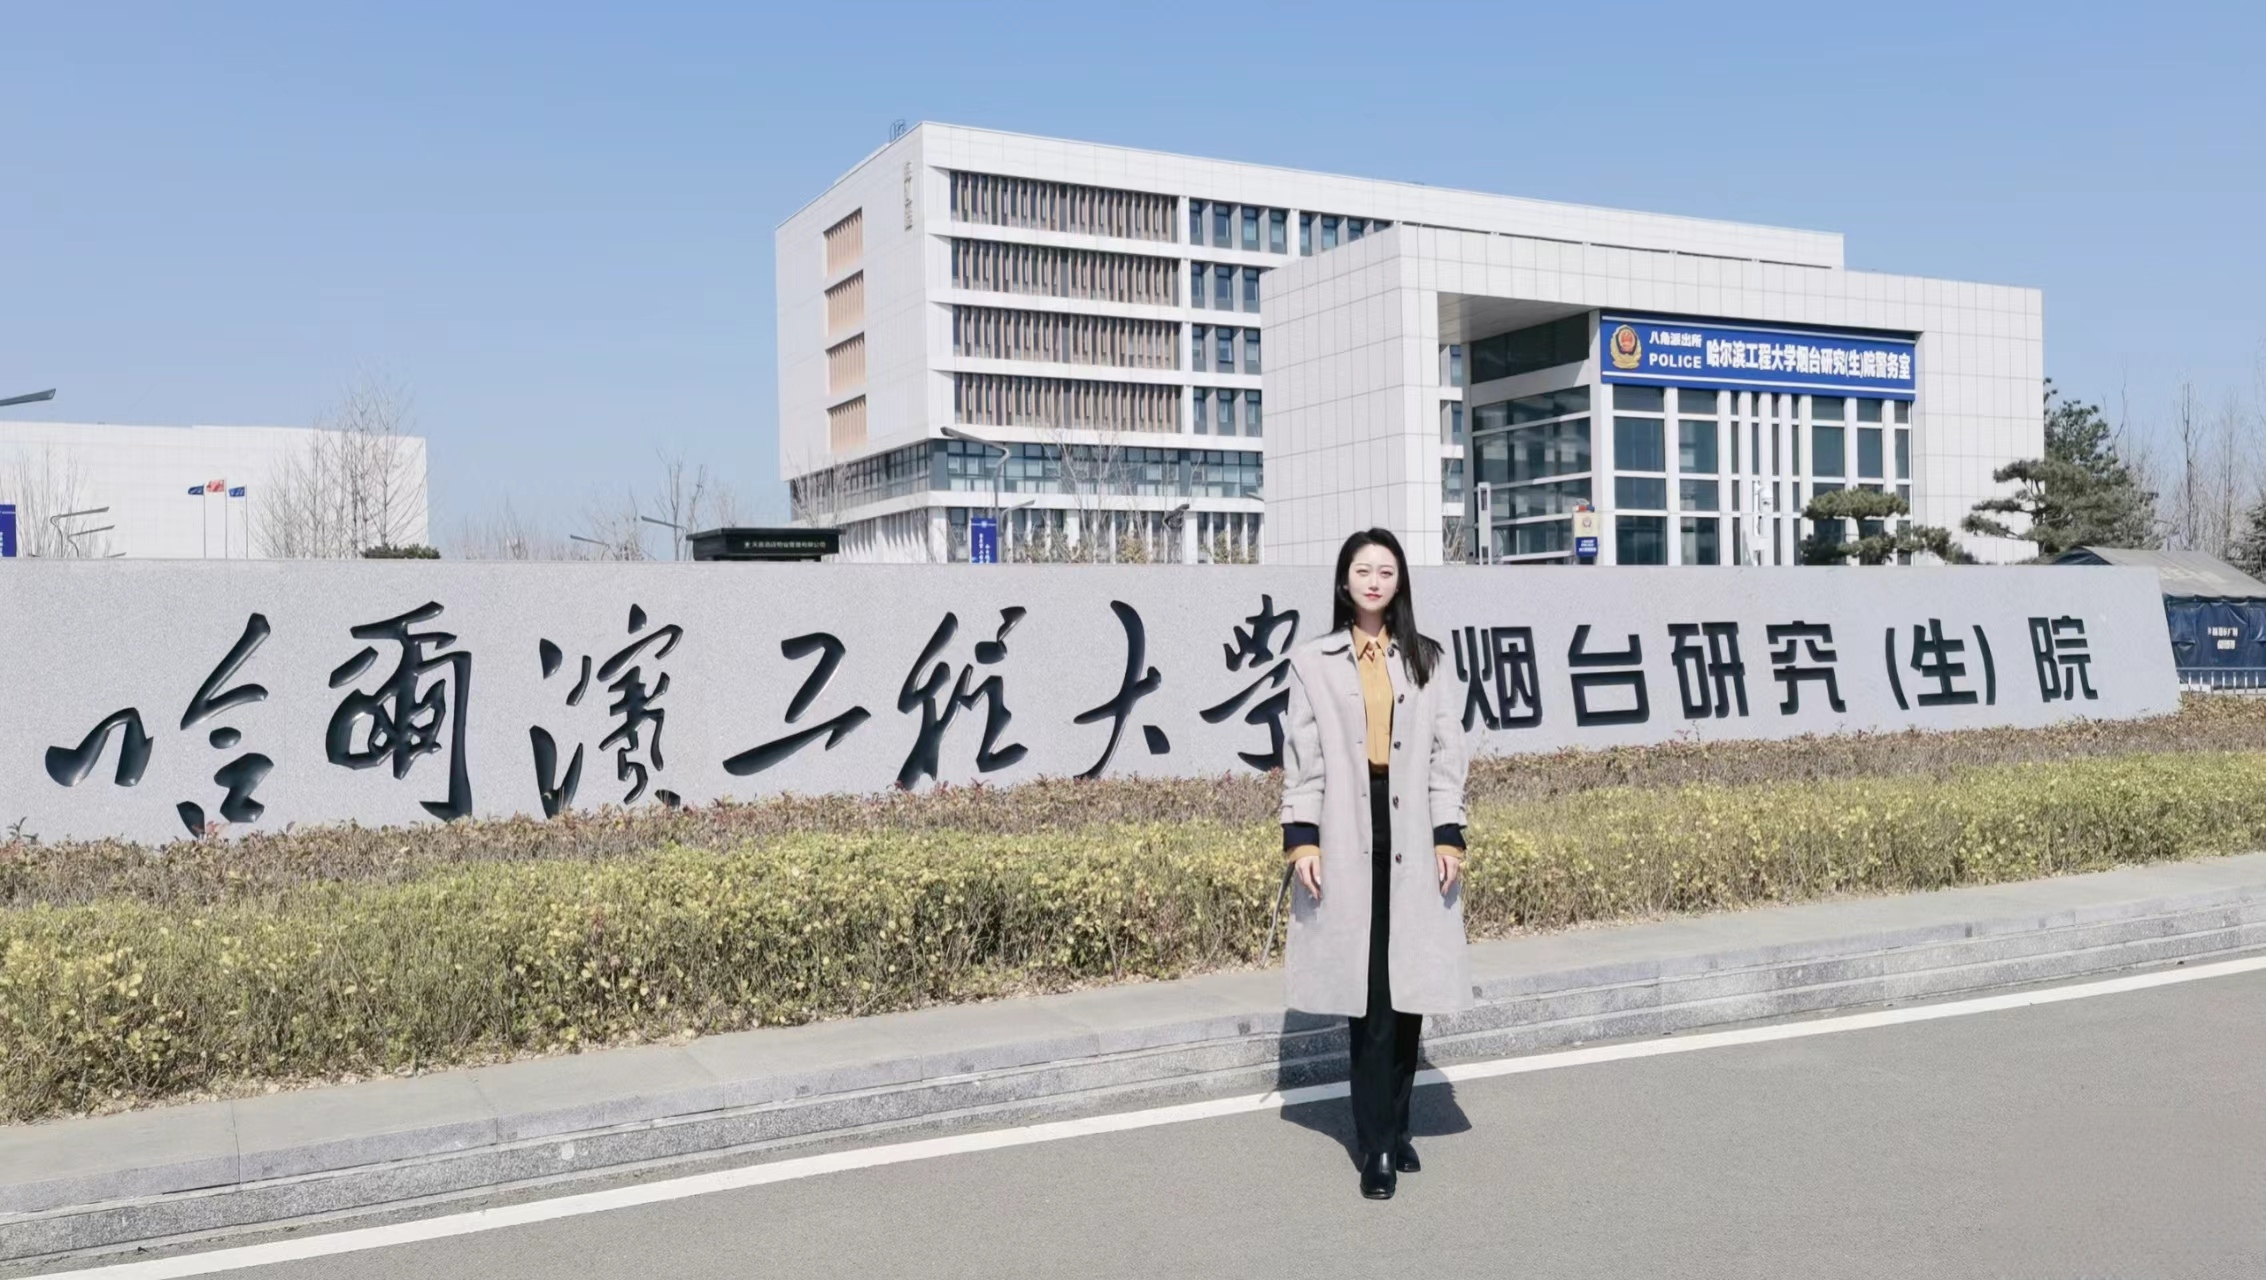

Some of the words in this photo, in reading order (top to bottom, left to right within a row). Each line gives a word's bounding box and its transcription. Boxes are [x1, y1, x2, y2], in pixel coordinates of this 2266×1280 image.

[1649, 331, 1702, 348] 八角派出所
[1649, 353, 1702, 369] POLICE
[1706, 338, 1911, 380] 哈尔滨工程大学烟台研究(生)院警务室
